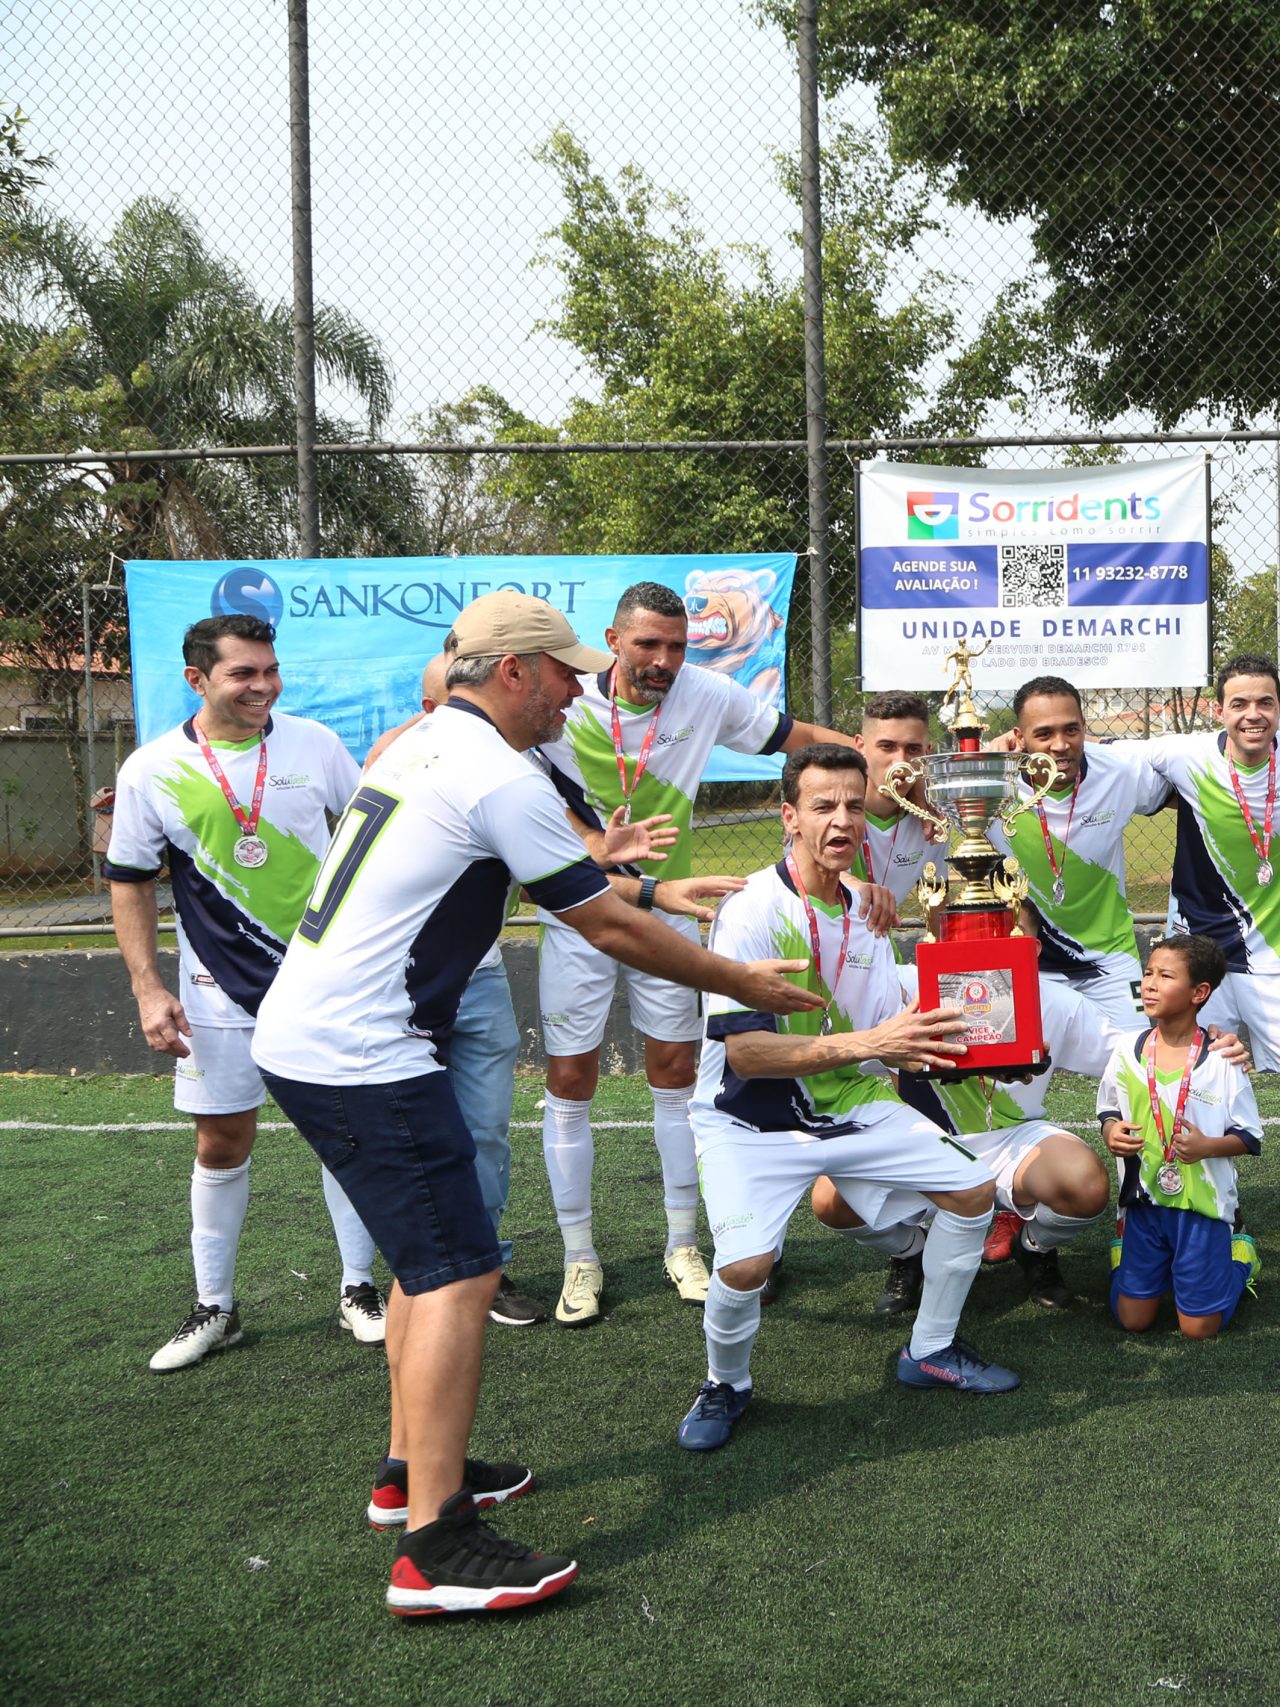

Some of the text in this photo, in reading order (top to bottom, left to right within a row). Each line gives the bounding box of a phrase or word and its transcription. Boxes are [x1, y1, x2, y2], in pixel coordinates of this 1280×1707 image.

[968, 491, 1161, 523] Sorridents
[1050, 526, 1096, 537] como
[1108, 524, 1161, 535] sorrir
[892, 561, 977, 573] AGENDE SUA
[1072, 565, 1188, 581] 11 93232-8778
[895, 578, 978, 593] AVALIAÇÃO !
[902, 617, 1181, 640] UNIDADE DEMARCHI
[1048, 643, 1112, 653] DEMARCHI
[982, 658, 1015, 668] LADO
[1020, 657, 1038, 667] DO
[1042, 656, 1109, 666] BRADESCO
[969, 1026, 989, 1034] VICE
